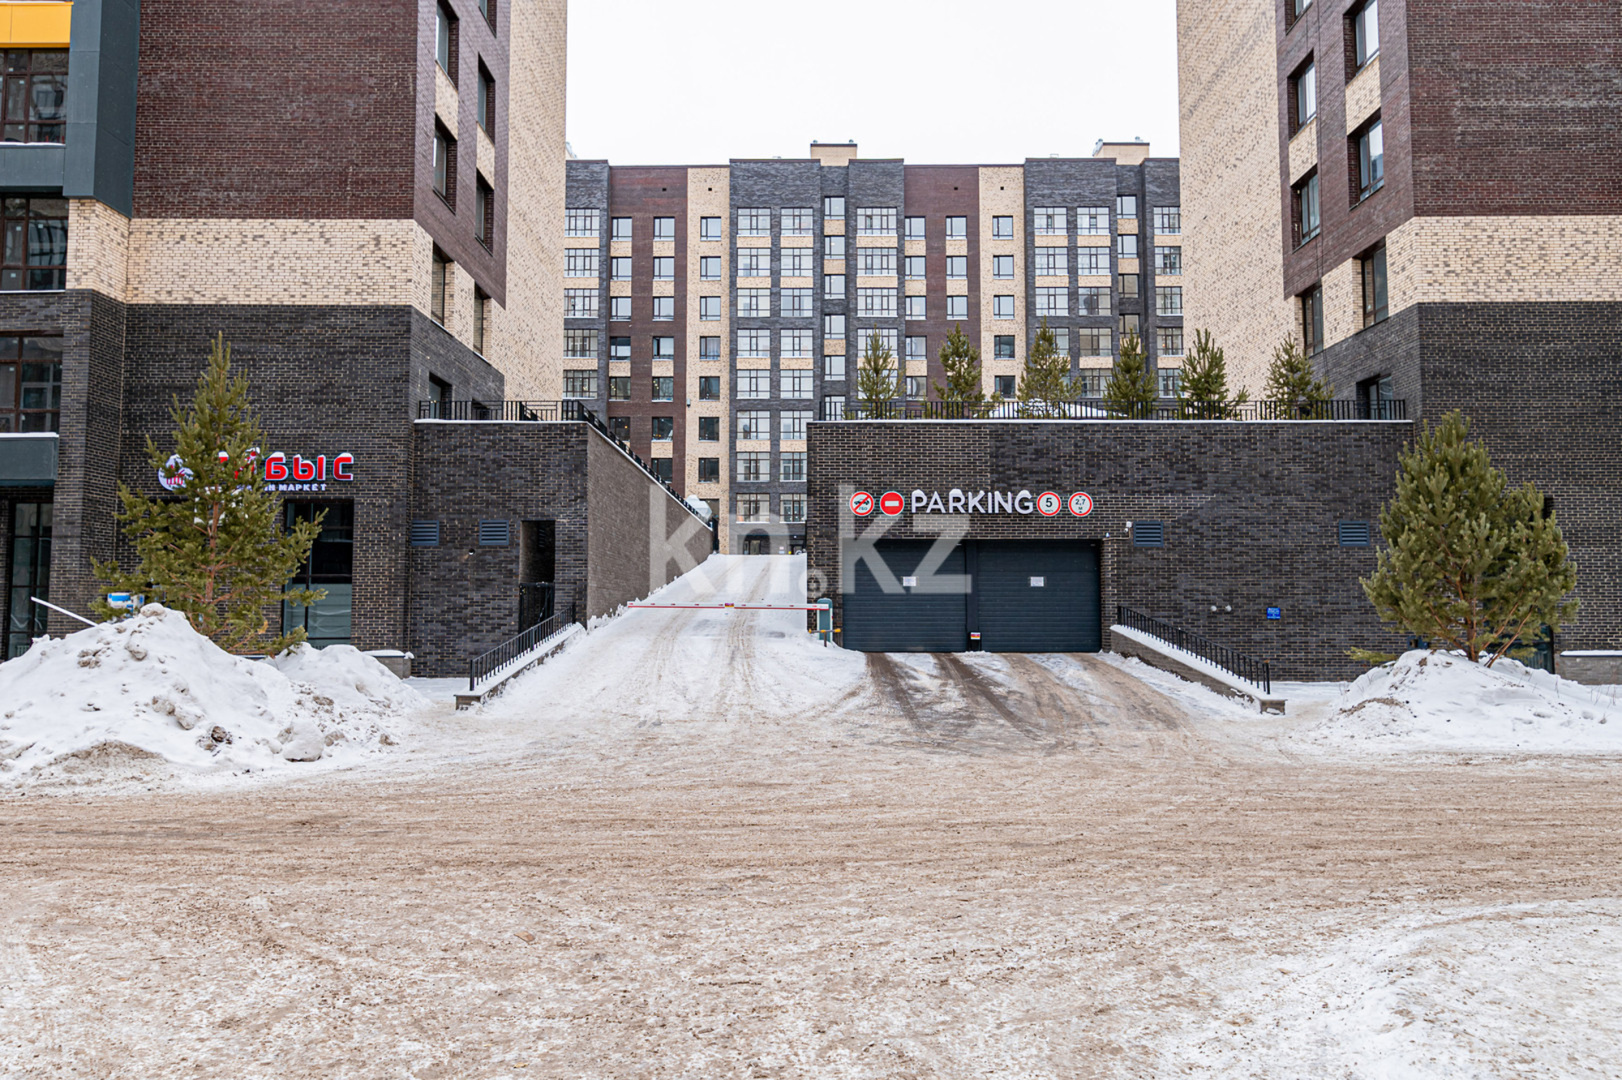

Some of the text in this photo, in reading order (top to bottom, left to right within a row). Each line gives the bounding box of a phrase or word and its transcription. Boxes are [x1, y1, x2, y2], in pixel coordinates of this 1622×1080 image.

[278, 483, 327, 491] МАРКЕТ
[911, 489, 1034, 514] PARKING
[1045, 497, 1053, 508] 5
